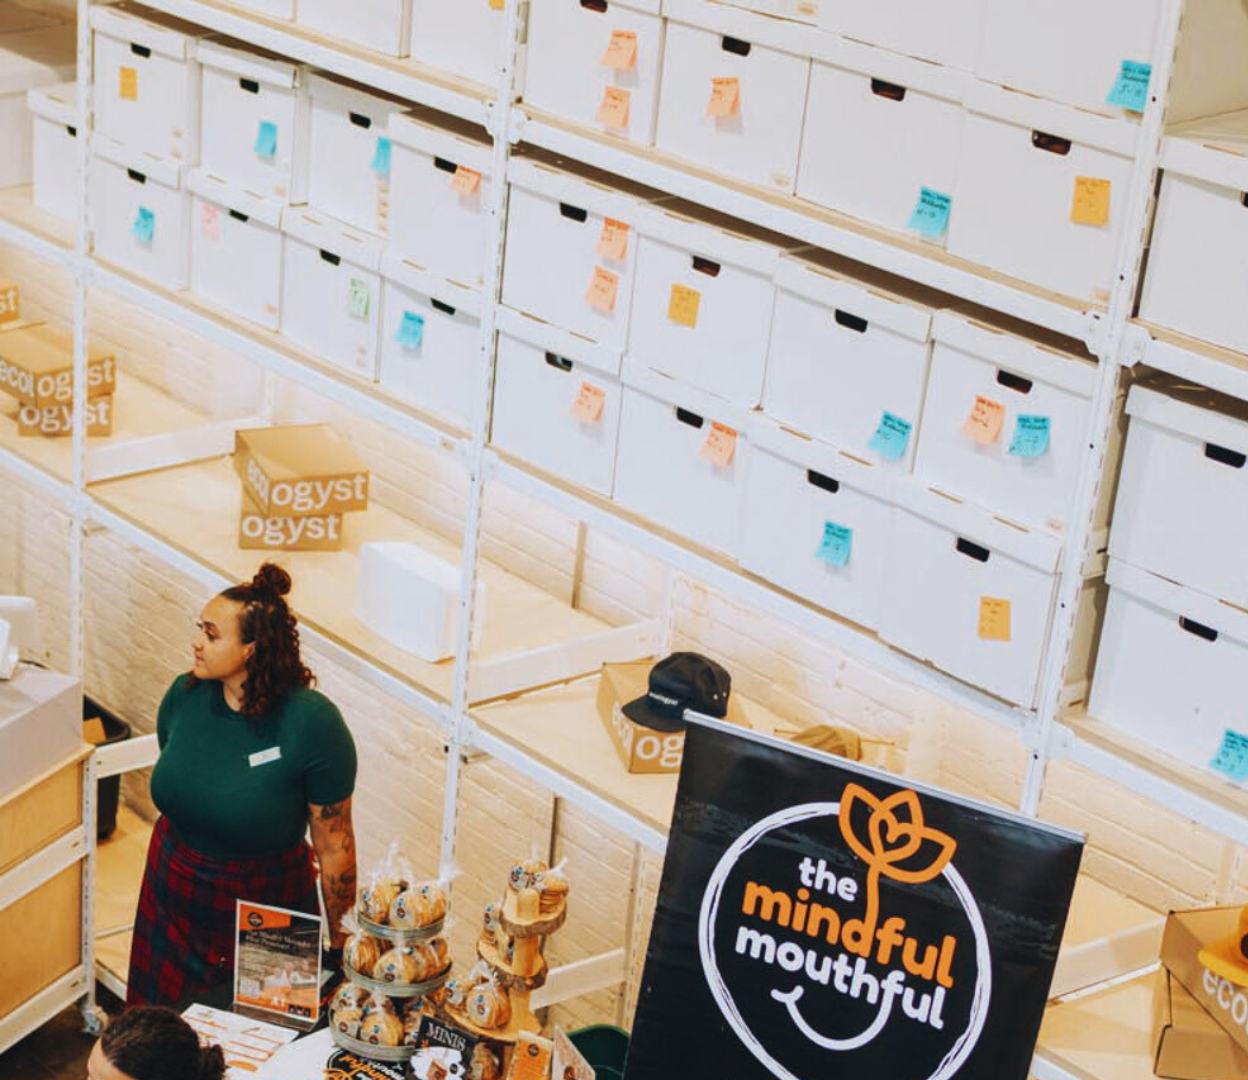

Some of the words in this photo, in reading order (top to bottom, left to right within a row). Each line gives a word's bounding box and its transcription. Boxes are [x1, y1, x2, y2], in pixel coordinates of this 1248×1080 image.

[798, 856, 858, 902] the
[735, 924, 945, 1030] mouthful
[741, 880, 957, 987] mindful
[1202, 966, 1248, 1036] eco
